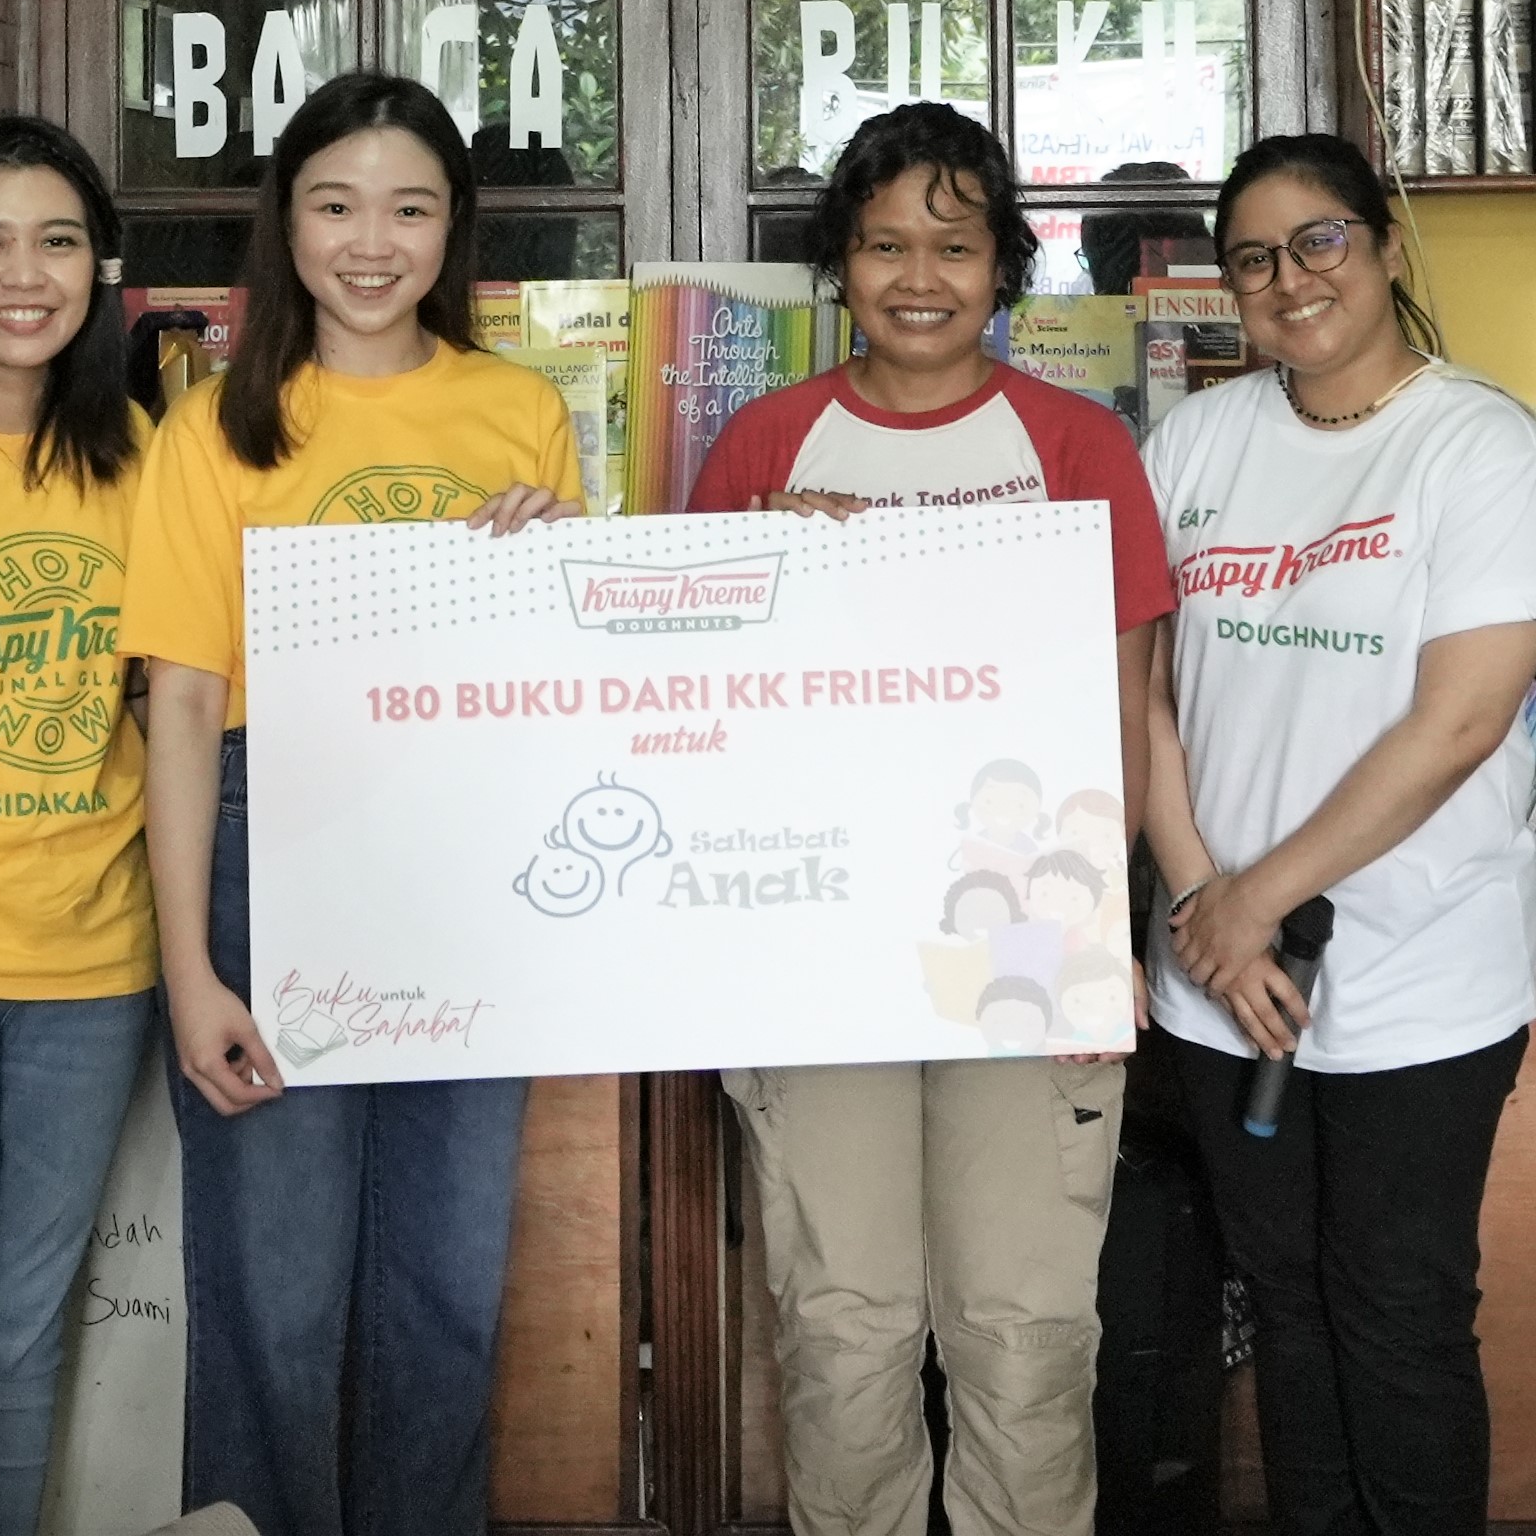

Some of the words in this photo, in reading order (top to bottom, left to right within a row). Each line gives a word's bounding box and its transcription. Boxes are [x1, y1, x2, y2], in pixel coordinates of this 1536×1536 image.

[713, 307, 765, 340] Arts
[545, 365, 557, 373] DI
[559, 364, 600, 373] LANGIT
[689, 335, 780, 370] Through
[1031, 342, 1111, 361] Menjelajahi
[552, 375, 600, 385] ACAAN
[660, 364, 693, 386] the
[693, 362, 807, 395] Intelligence
[1022, 360, 1088, 379] Waktu
[678, 398, 701, 424] of
[706, 401, 722, 416] a
[344, 482, 459, 523] HOT
[857, 492, 905, 508] nak
[917, 475, 1040, 507] Indonesia
[1178, 509, 1218, 529] EAT
[1271, 513, 1395, 590] Kreme
[581, 575, 678, 615] Krispy
[676, 572, 771, 610] Kreme
[57, 605, 120, 662] Kre
[615, 618, 734, 633] DOUGHNUTS
[1217, 618, 1384, 656] DOUGHNUTS
[78, 669, 120, 688] GLA
[365, 684, 441, 723] 180
[456, 677, 584, 720] BUKU
[600, 672, 710, 715] DARI
[726, 671, 788, 710] KK
[801, 664, 1002, 708] FRIENDS
[630, 719, 728, 756] untuk
[690, 825, 850, 854] Sahabat
[657, 855, 851, 910] Anak
[272, 968, 379, 1026] Buku
[380, 986, 426, 1002] untuk
[346, 998, 495, 1048] Sahabat
[80, 1277, 171, 1326] Suami
